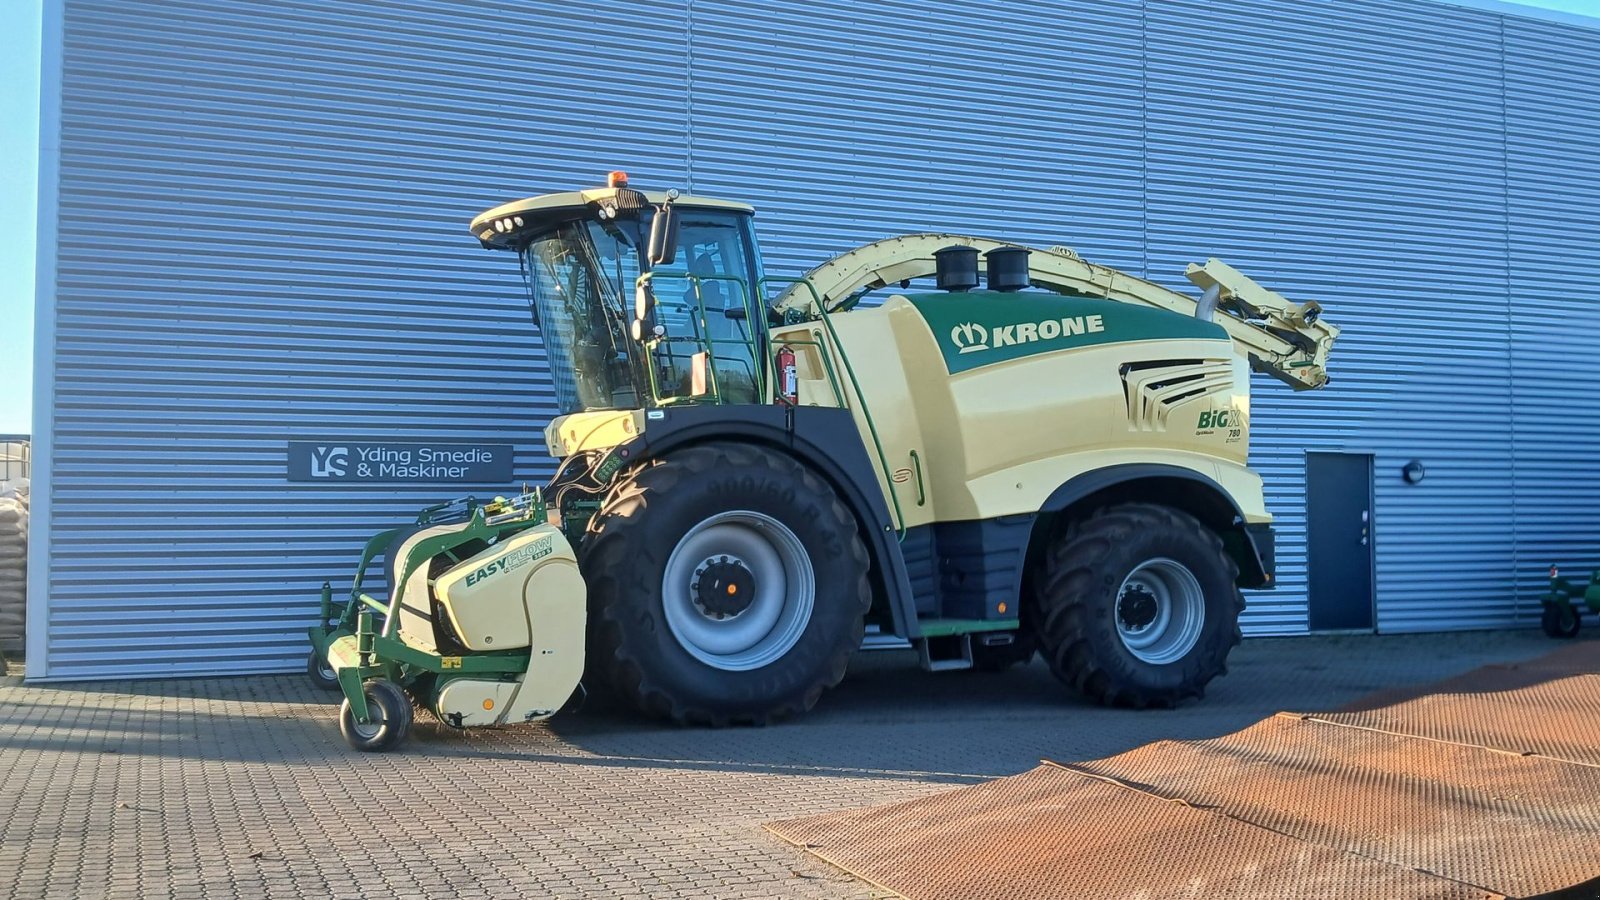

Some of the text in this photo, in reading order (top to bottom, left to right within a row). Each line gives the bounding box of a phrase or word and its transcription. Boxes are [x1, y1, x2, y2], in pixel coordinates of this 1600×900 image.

[993, 315, 1105, 348] KRONE
[1228, 429, 1241, 438] 780
[356, 447, 493, 465] Yding Smedie
[356, 463, 469, 478] & Maskiner
